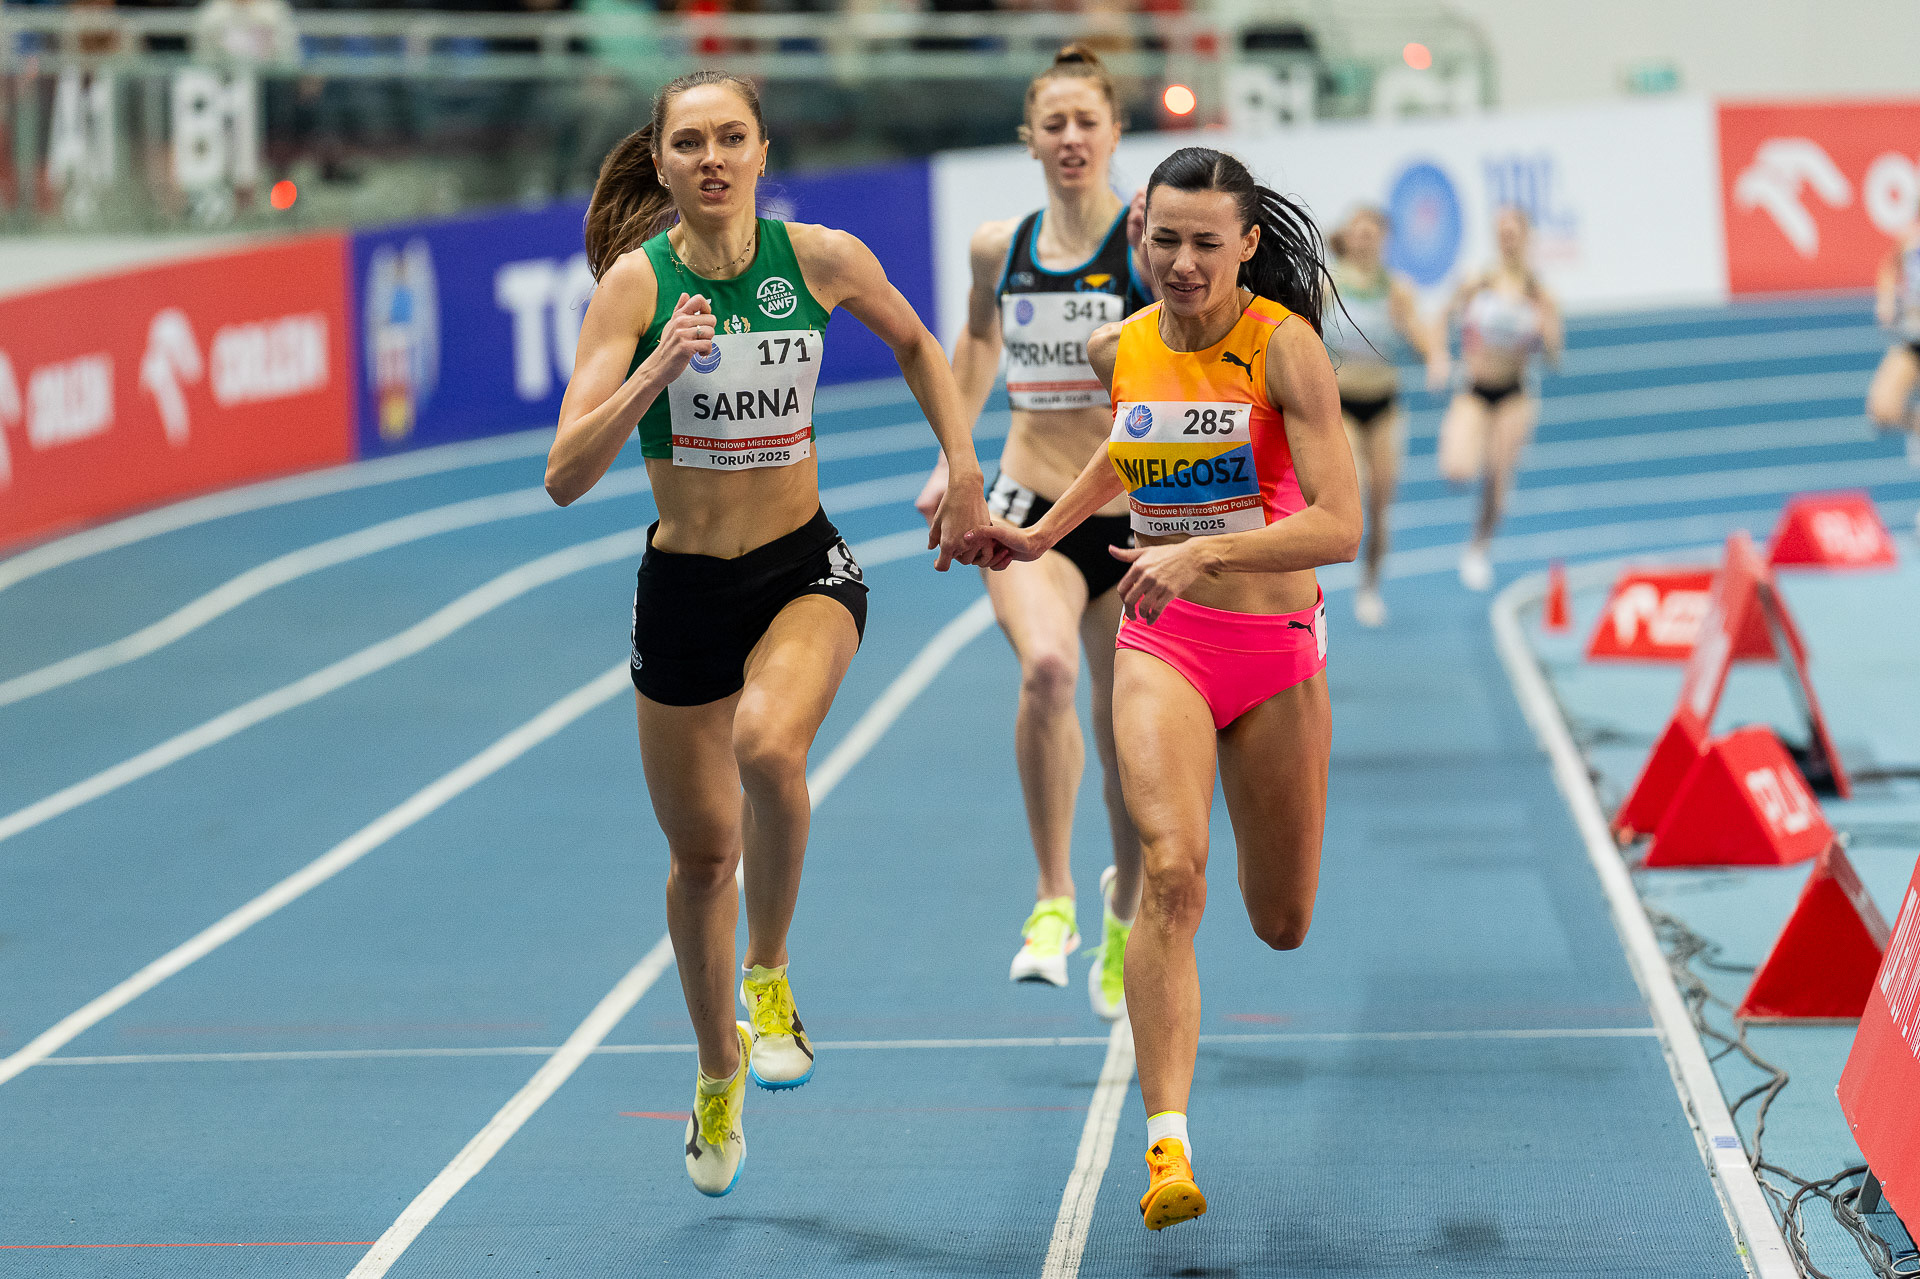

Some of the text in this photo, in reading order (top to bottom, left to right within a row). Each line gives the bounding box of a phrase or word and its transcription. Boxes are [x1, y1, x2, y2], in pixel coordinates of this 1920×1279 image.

[174, 68, 258, 184] B1
[761, 291, 793, 303] WARSZAWA
[763, 282, 787, 297] AZS
[767, 297, 793, 313] AWF
[1063, 300, 1108, 321] 341
[757, 337, 811, 365] 171
[692, 386, 800, 421] SARNA
[1182, 409, 1236, 435] 285
[679, 437, 692, 446] 69.
[693, 440, 713, 448] PZLA
[713, 440, 746, 450] Halowe
[747, 436, 794, 448] Mistrzostwa
[709, 450, 791, 466] TORUŃ 2025
[1115, 456, 1249, 488] WIELGOSZ
[1148, 506, 1178, 515] Halowe
[1179, 503, 1229, 516] Mistrzostwa
[1230, 499, 1257, 510] Polski
[1147, 518, 1226, 532] TORUŃ 2025
